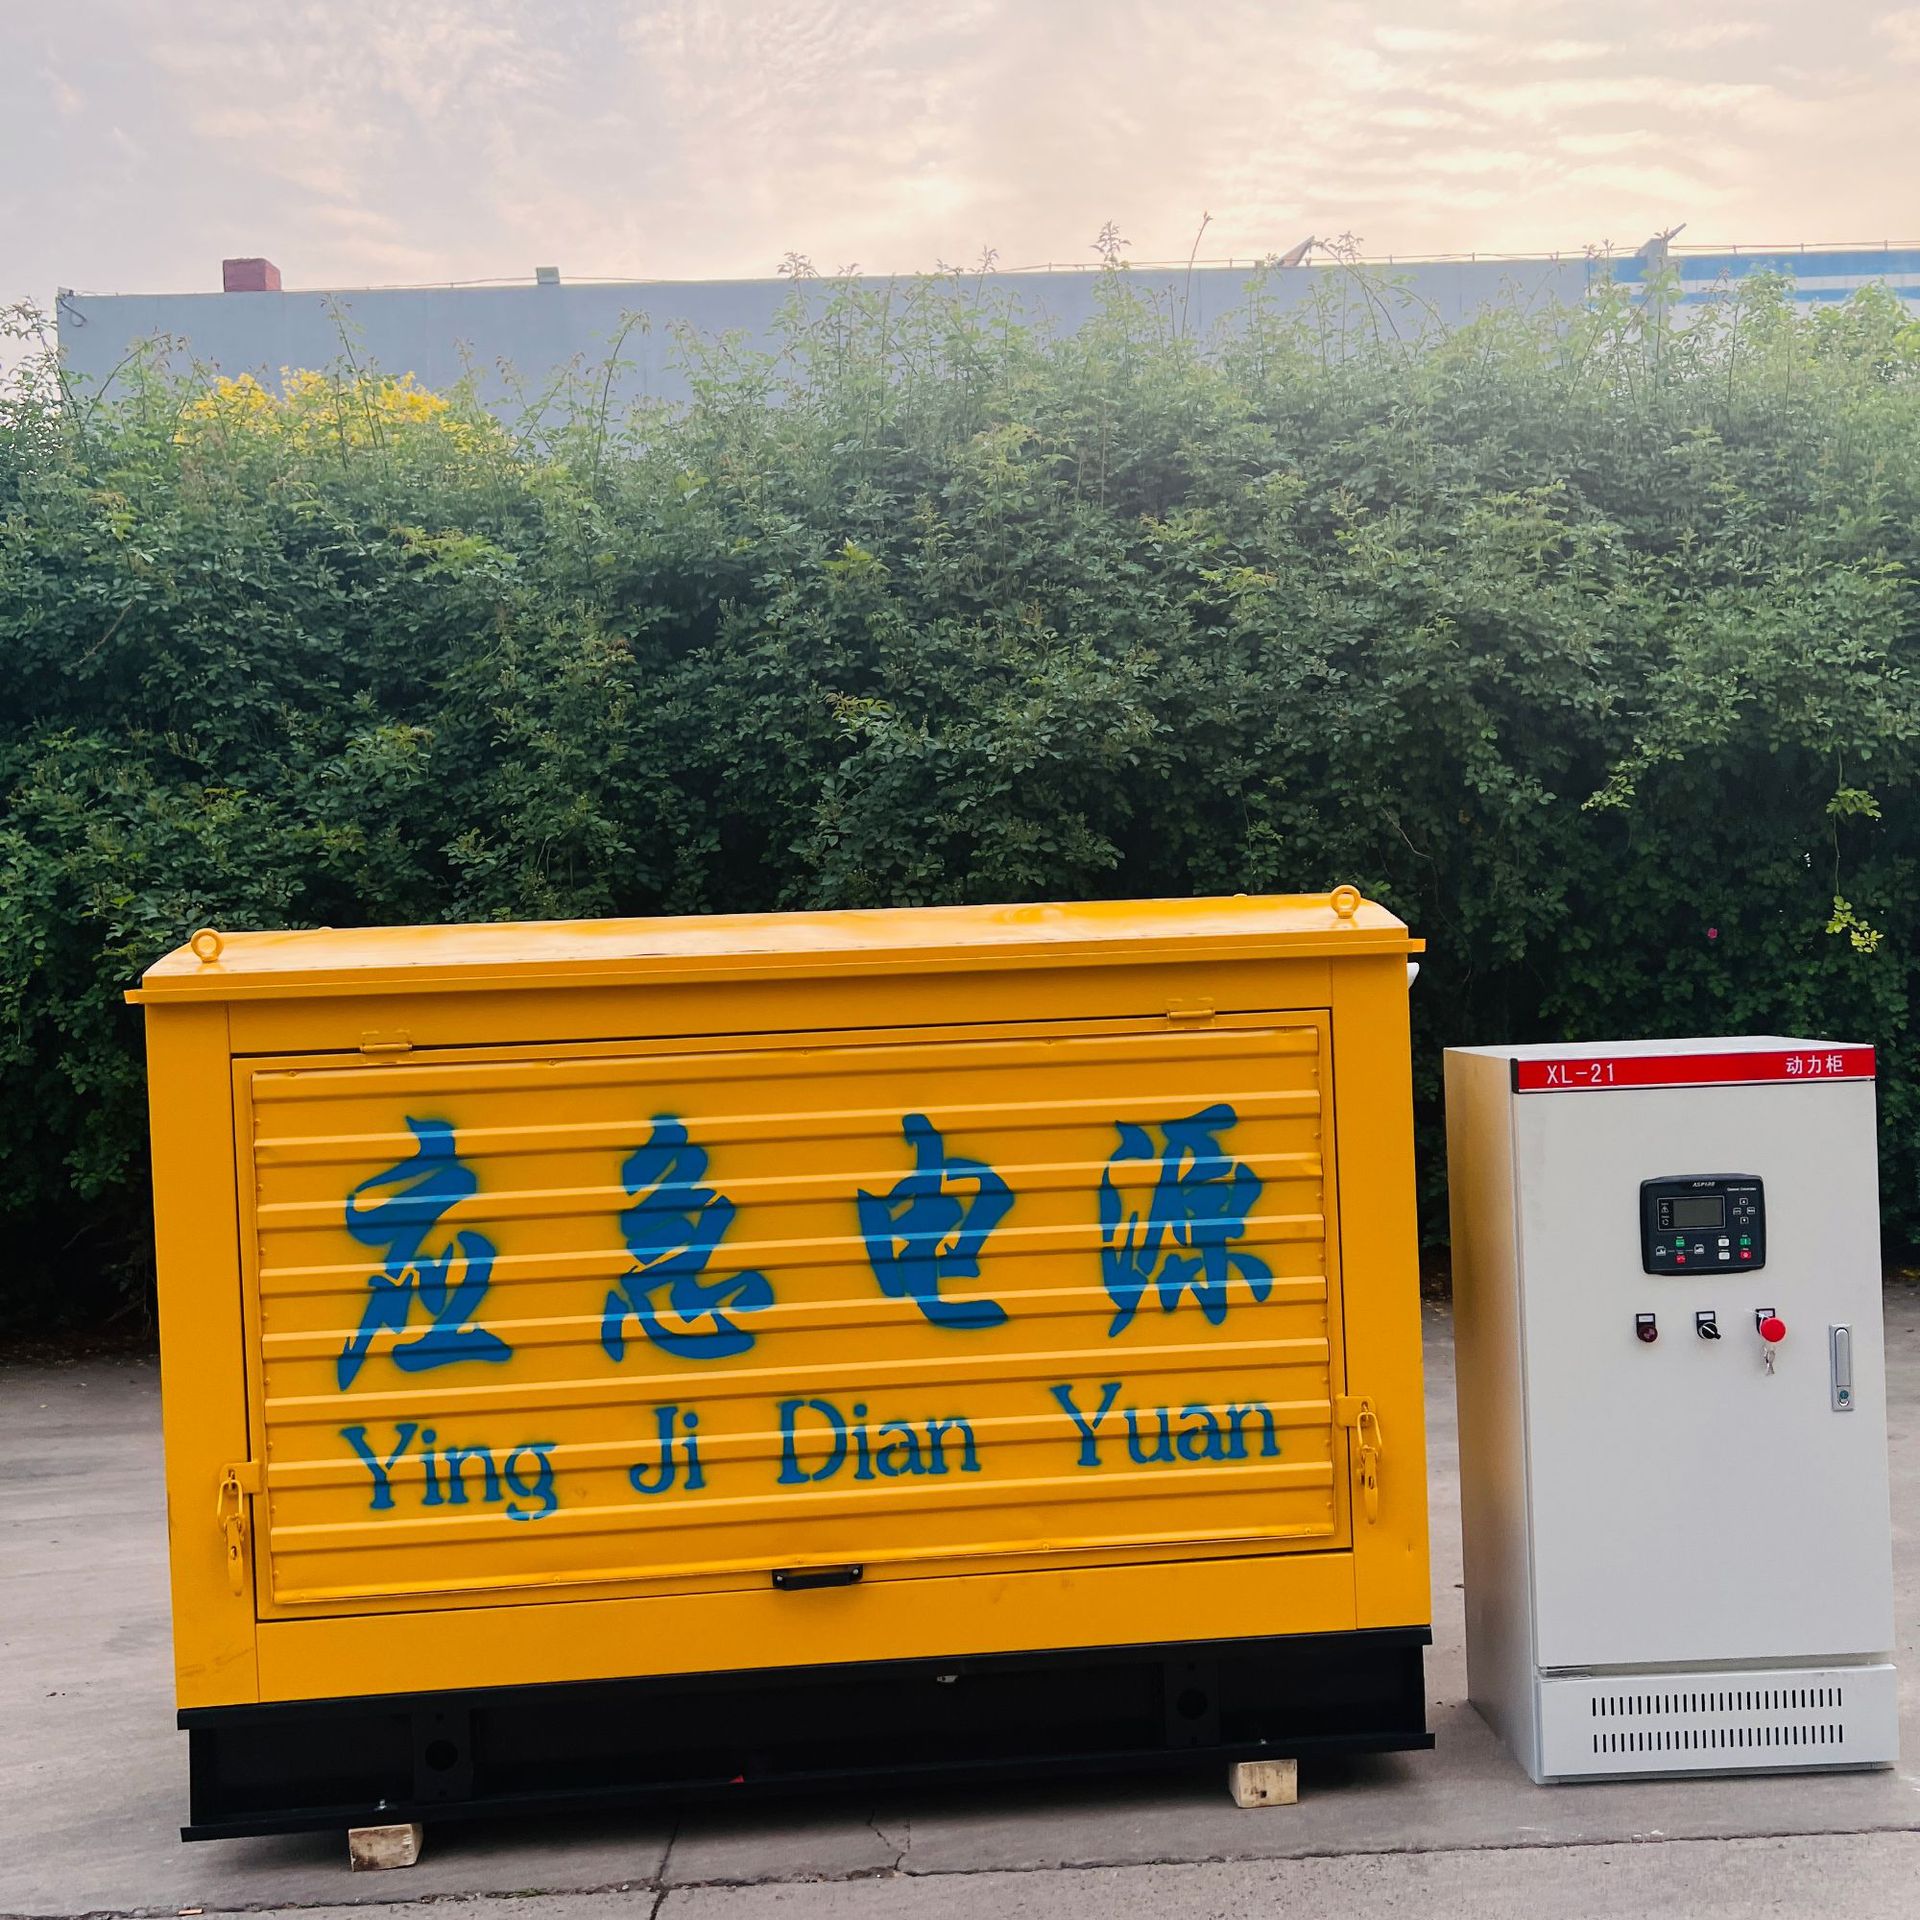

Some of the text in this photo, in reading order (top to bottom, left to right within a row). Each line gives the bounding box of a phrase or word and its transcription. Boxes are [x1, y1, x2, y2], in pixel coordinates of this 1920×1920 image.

[1546, 1062, 1616, 1085] XL-21
[1785, 1054, 1845, 1075] 动力柜
[339, 1382, 1281, 1521] Ying Ji Dian Yuan
